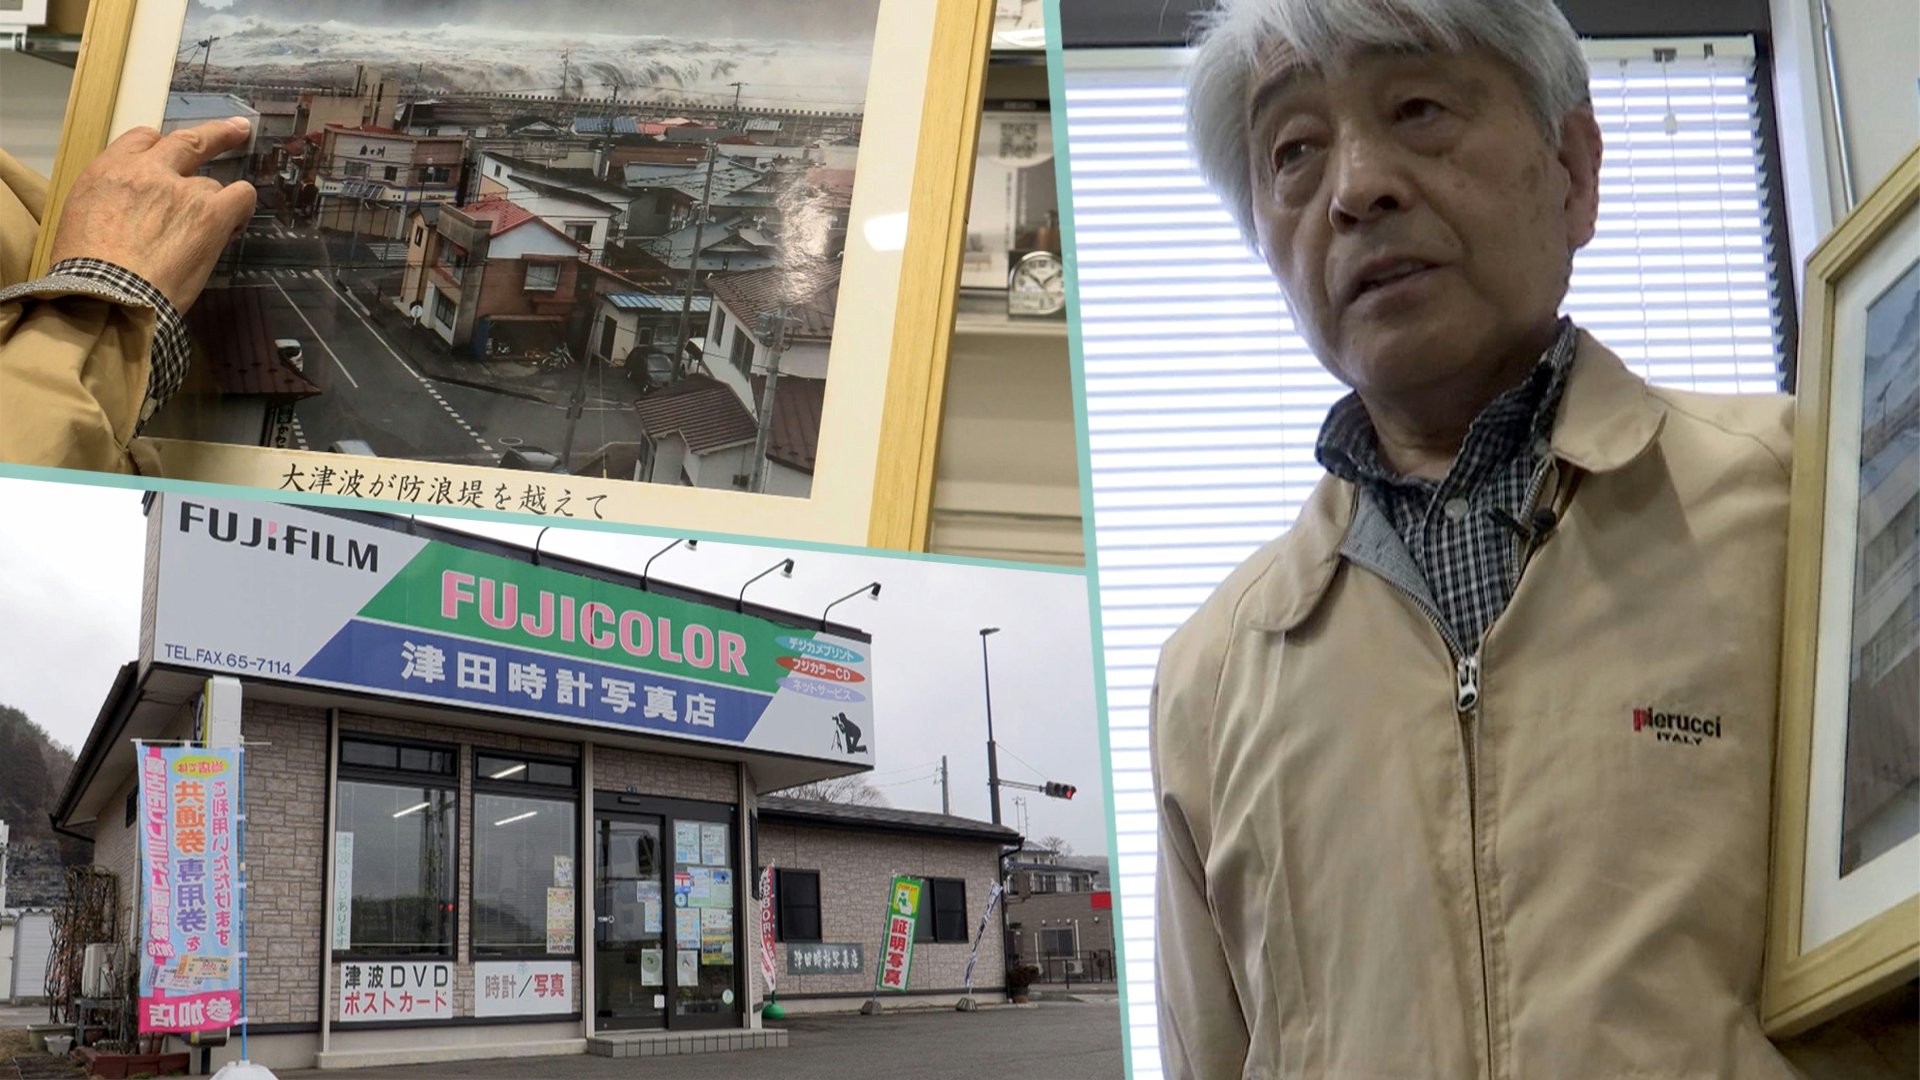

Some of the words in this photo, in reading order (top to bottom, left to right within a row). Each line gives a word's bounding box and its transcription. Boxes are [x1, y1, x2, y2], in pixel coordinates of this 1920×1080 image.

[281, 463, 608, 520] 大津波が防浪堤を越えて
[179, 501, 379, 573] FUJIFILM
[441, 569, 750, 677] FUJICOLOR
[164, 643, 293, 676] TEL.FAX.65-7114
[789, 637, 854, 661] デジカメプリント
[400, 639, 717, 728] 津田時計写真店
[792, 658, 851, 681] フジカラーCD
[793, 679, 852, 701] ネットサービス
[1656, 731, 1703, 746] ITALY
[883, 917, 909, 986] 証明写真
[344, 965, 448, 989] 津波DVD
[344, 990, 448, 1015] ポストカード
